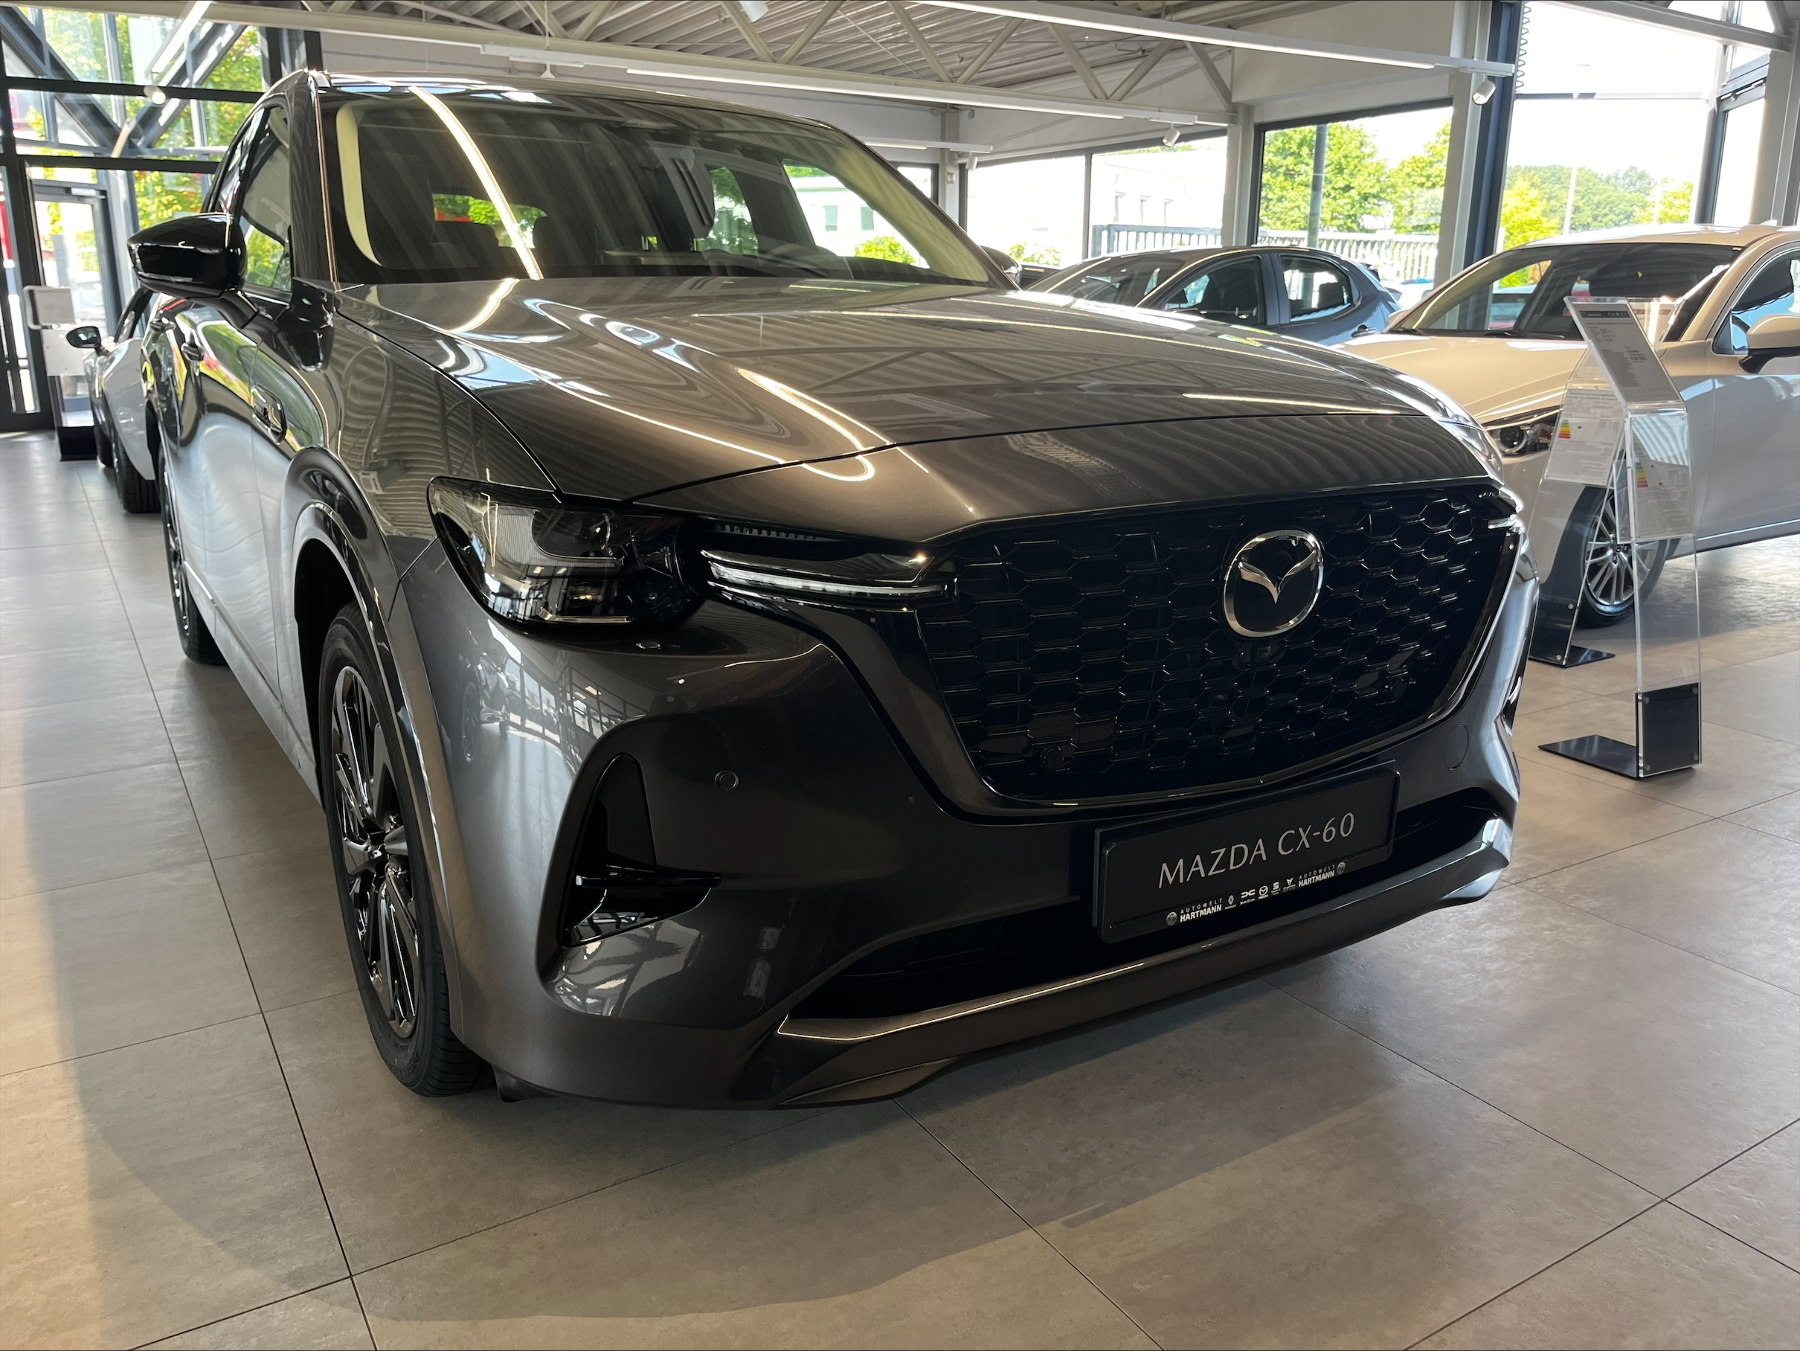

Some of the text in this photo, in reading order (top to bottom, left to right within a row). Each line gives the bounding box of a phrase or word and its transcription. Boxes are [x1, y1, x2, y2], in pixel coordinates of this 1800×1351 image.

[1158, 812, 1355, 889] MAZDA CX-60
[1298, 870, 1335, 888] HARTMANN
[1179, 904, 1222, 923] HARTMANN
[1180, 898, 1223, 914] AUTOWELT
